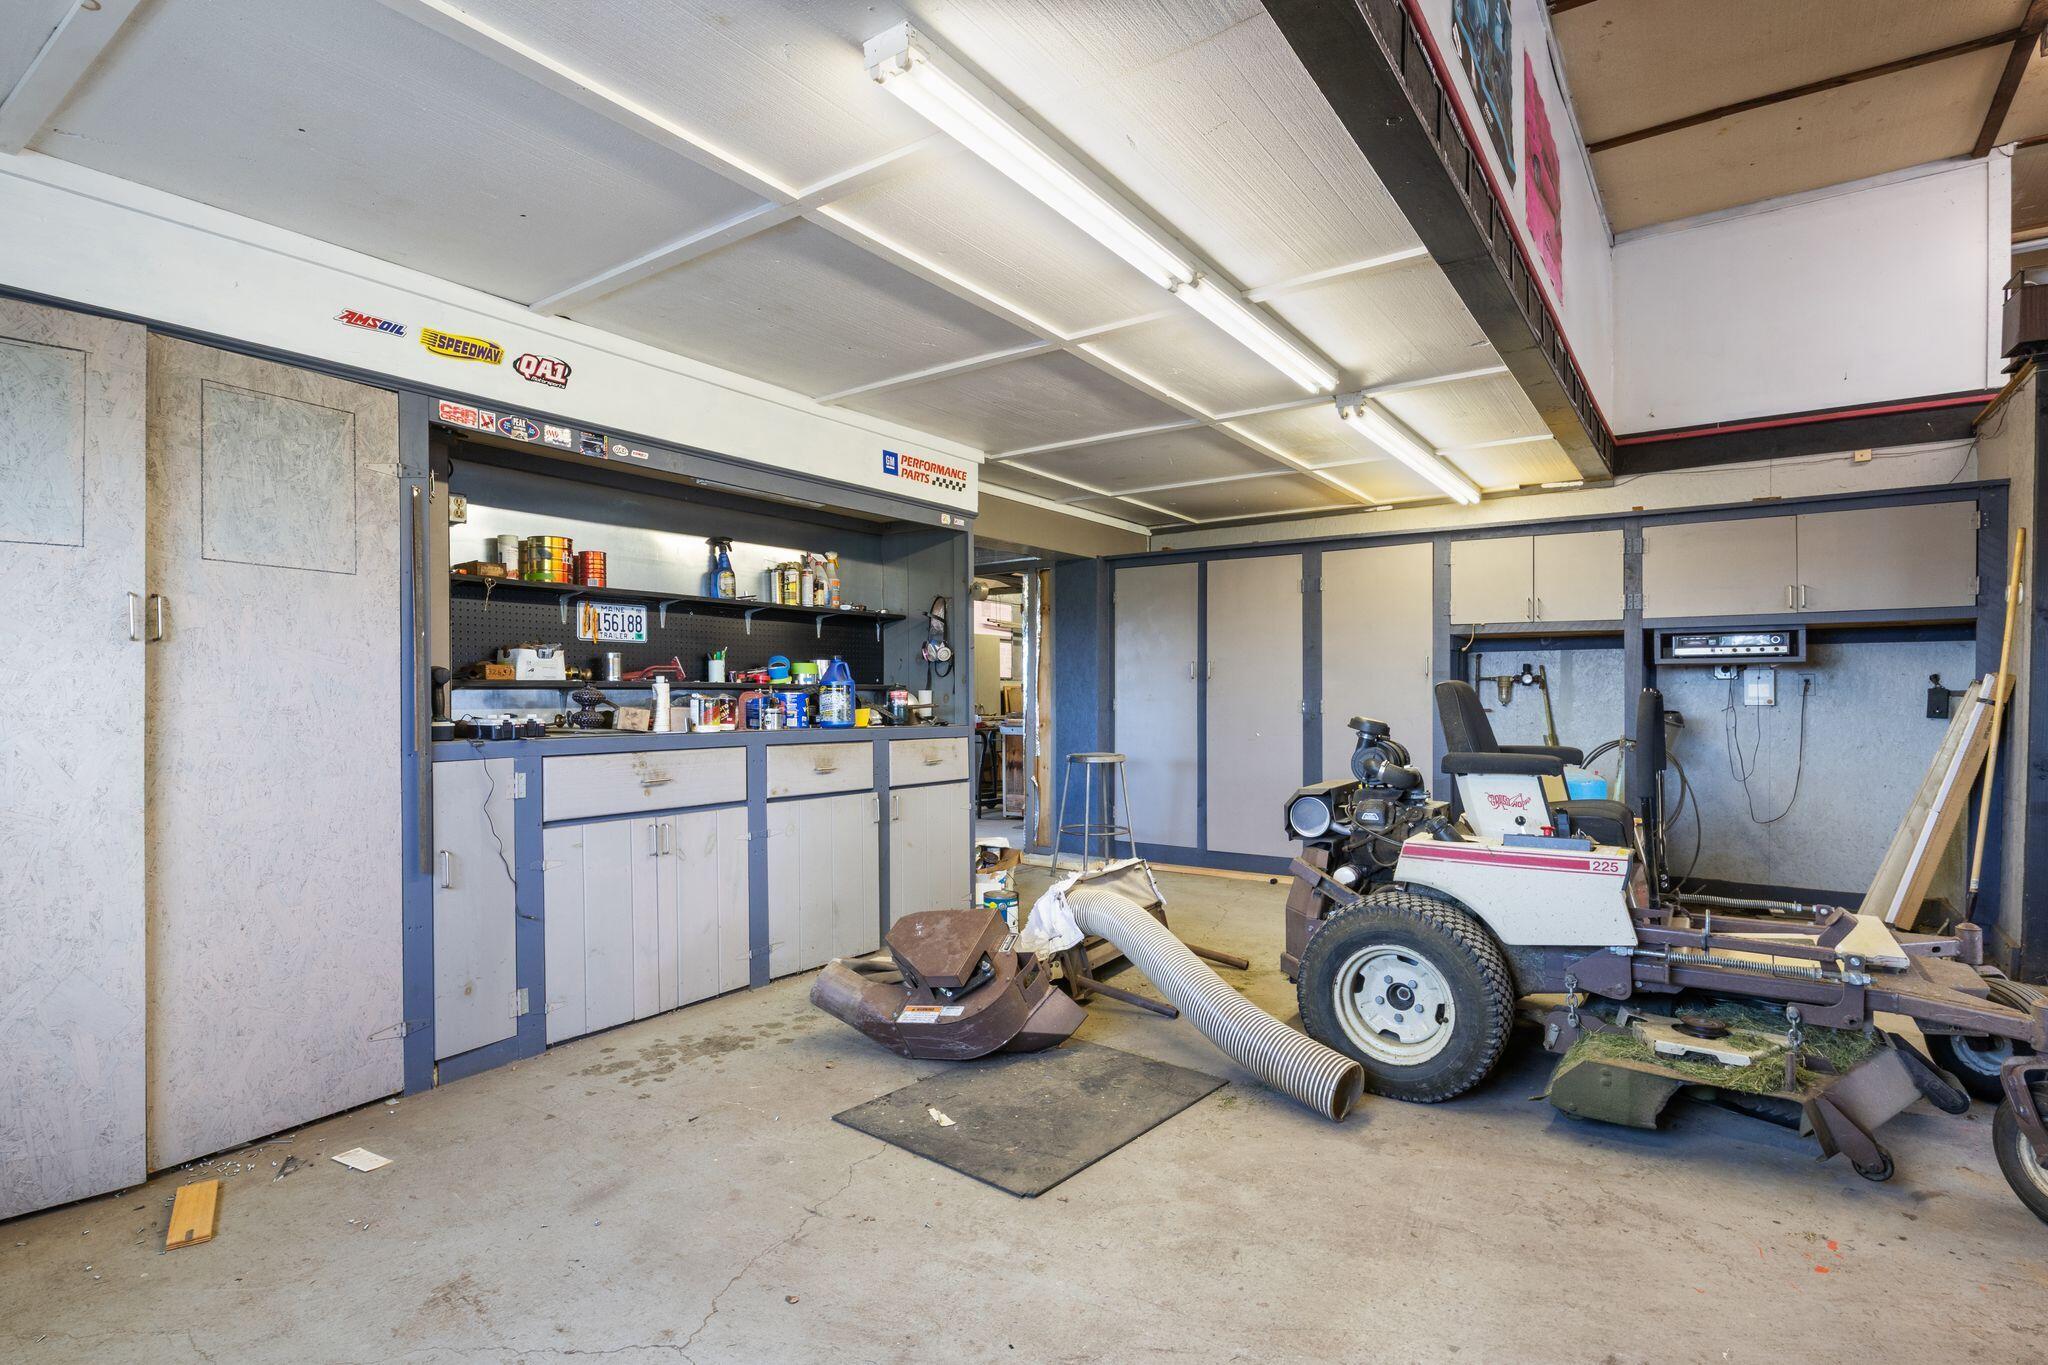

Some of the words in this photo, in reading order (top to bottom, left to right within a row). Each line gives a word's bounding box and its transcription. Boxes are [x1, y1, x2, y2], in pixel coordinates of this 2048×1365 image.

[338, 309, 405, 336] AMSOIL
[437, 334, 501, 362] SPEEDWAY
[518, 353, 567, 385] QA1
[900, 454, 967, 481] PERFORMANCE
[901, 468, 930, 484] PARTS
[599, 632, 628, 640] TRAILER
[1592, 860, 1619, 873] 225
